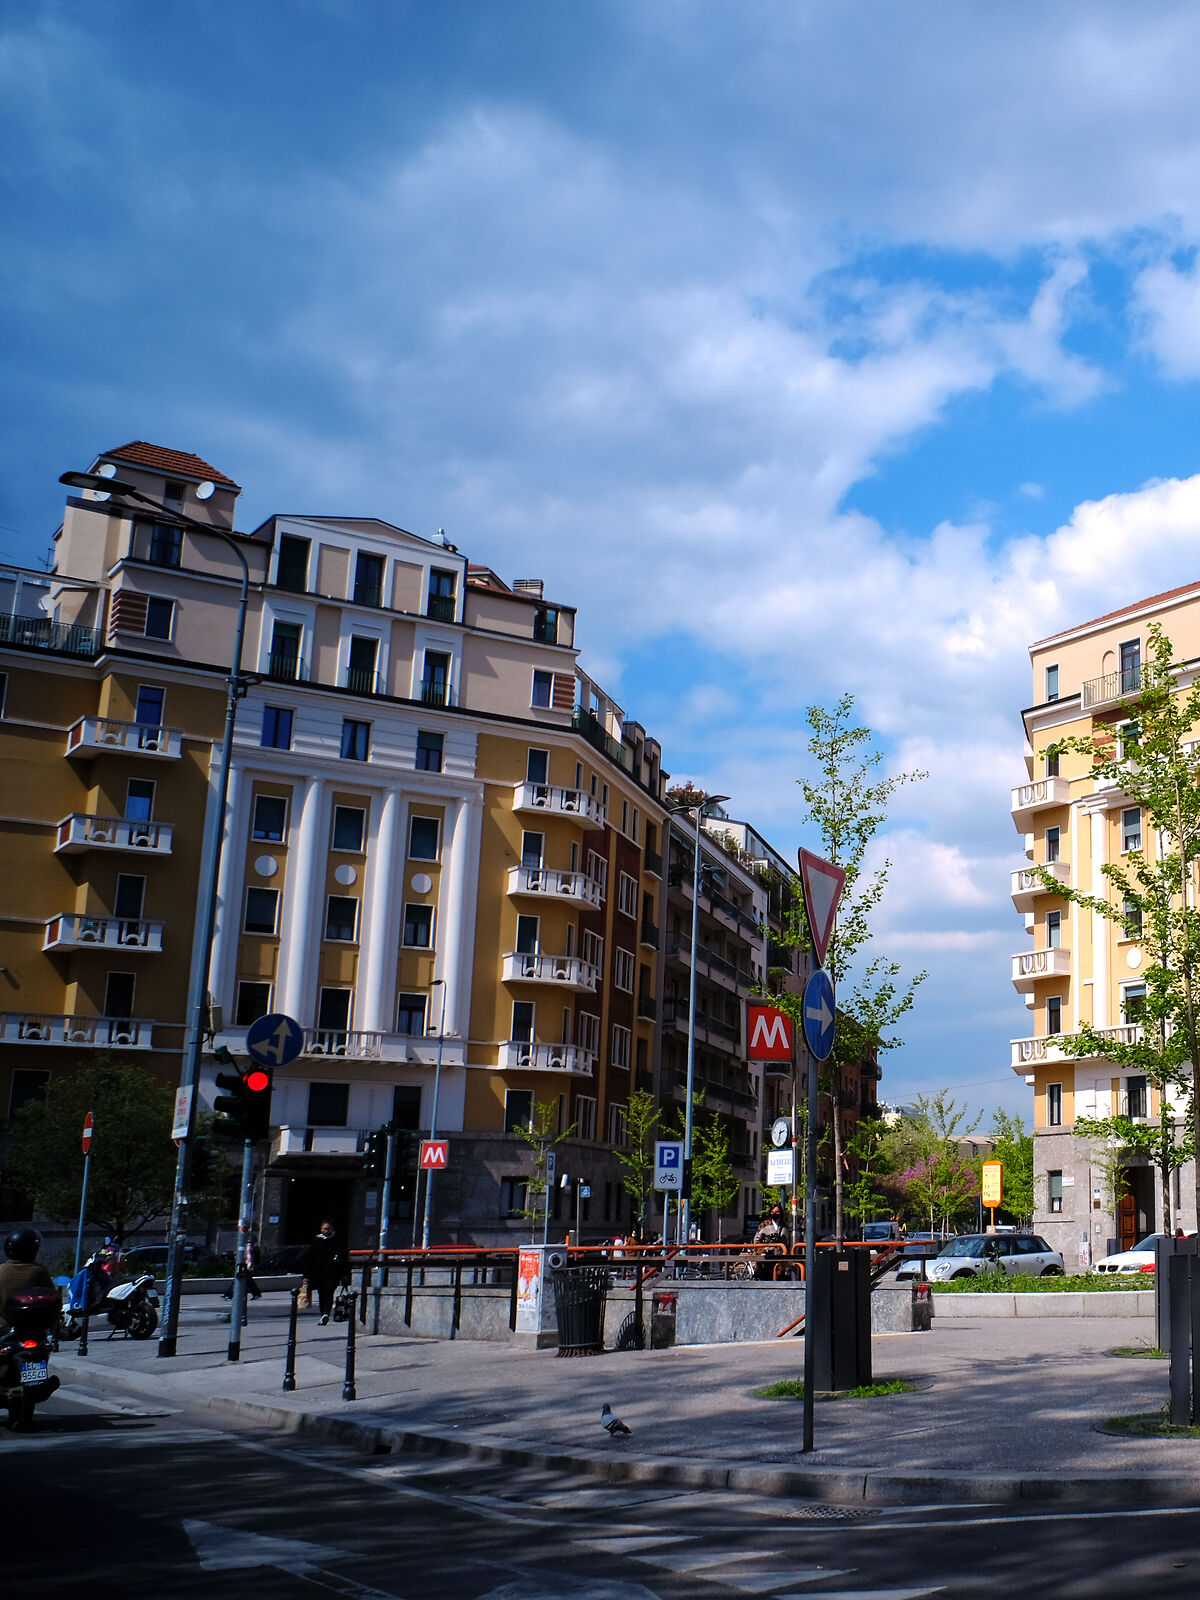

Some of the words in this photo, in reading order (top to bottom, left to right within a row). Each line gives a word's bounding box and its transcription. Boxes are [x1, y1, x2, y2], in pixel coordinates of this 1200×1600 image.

[750, 1015, 789, 1048] M
[423, 1147, 445, 1163] M
[663, 1149, 675, 1165] P
